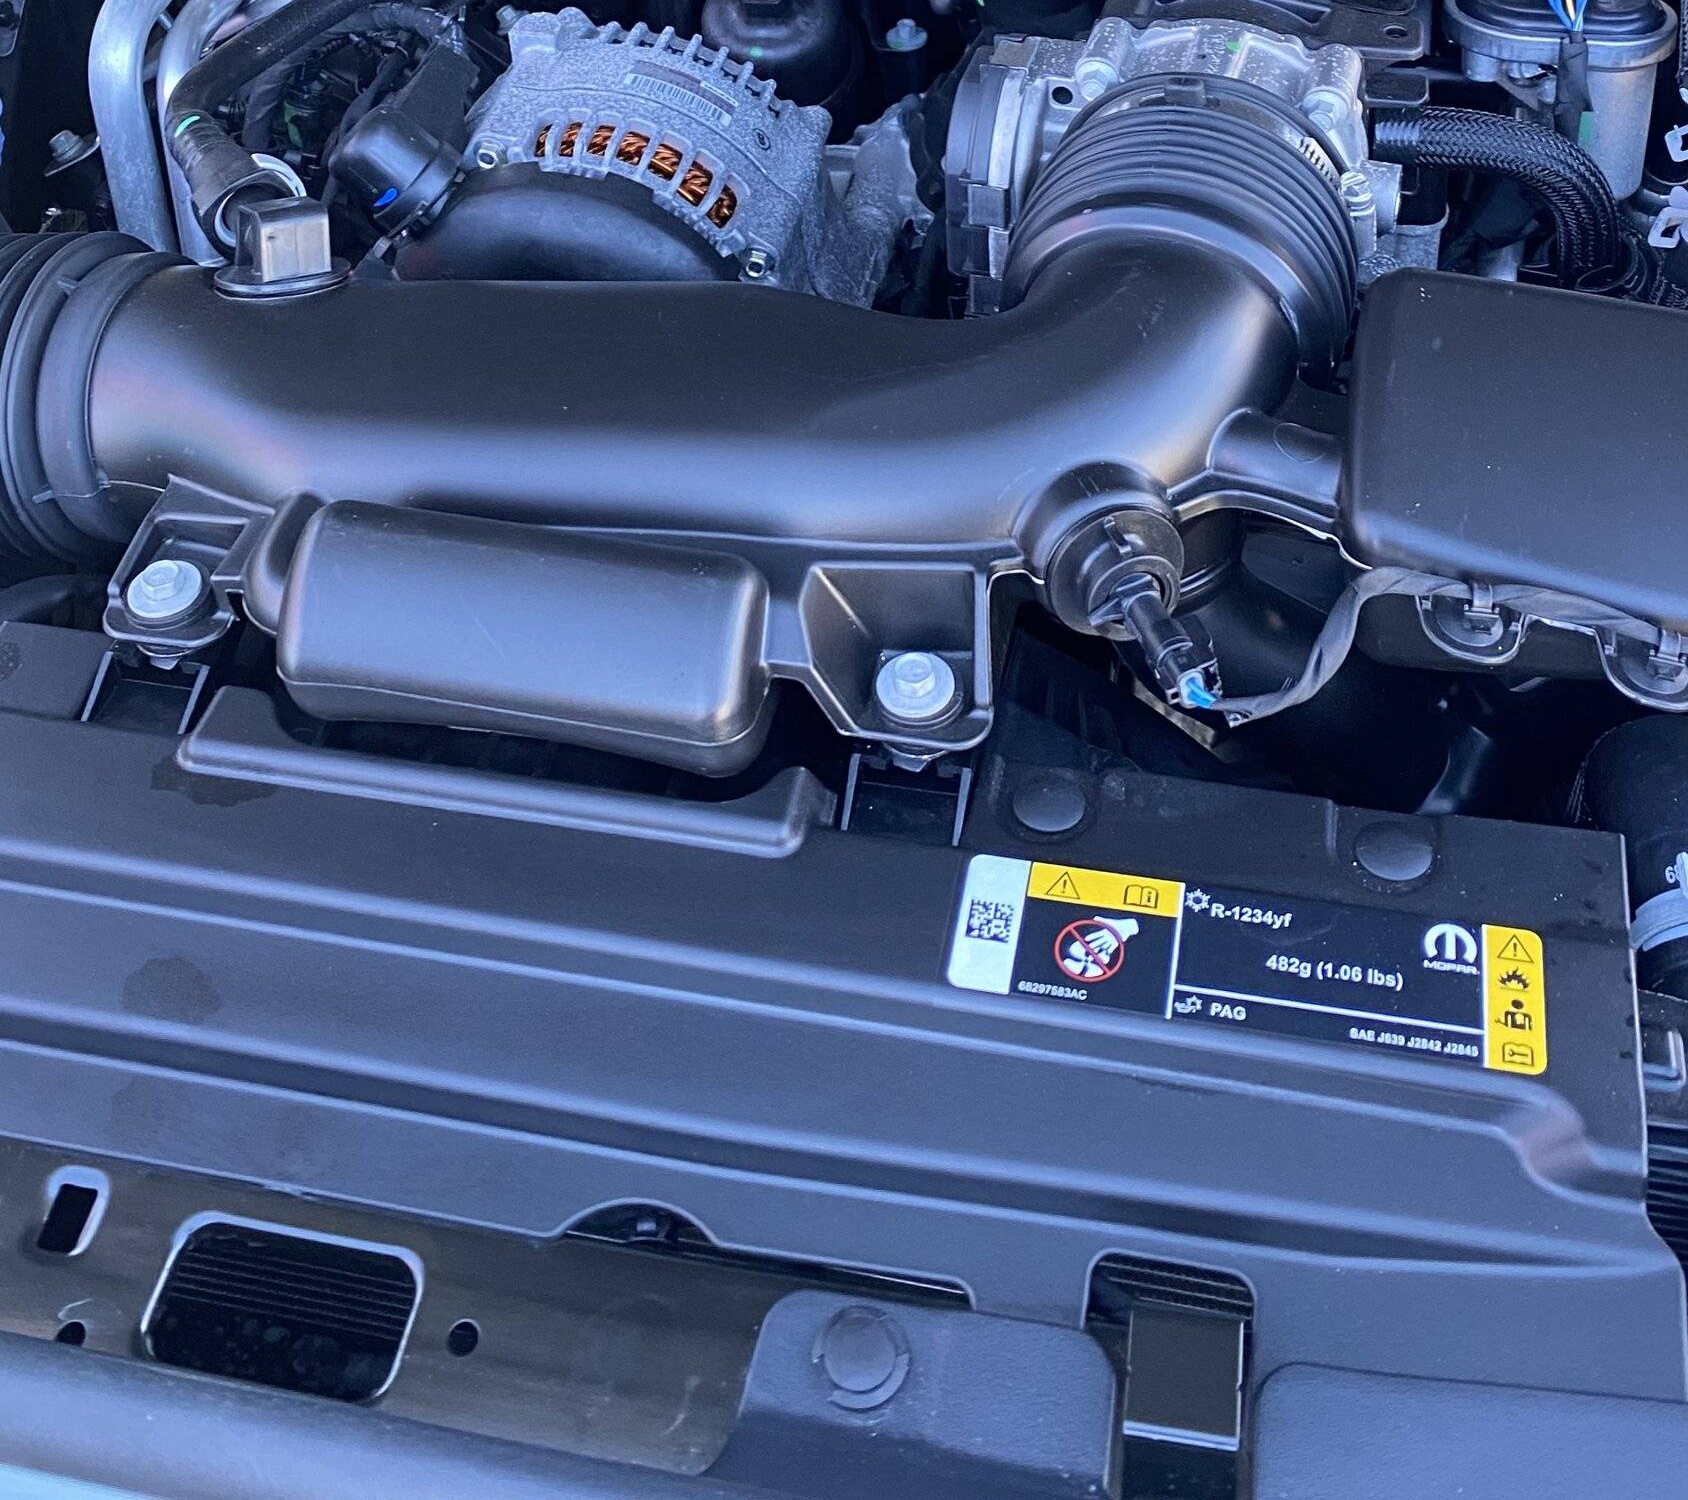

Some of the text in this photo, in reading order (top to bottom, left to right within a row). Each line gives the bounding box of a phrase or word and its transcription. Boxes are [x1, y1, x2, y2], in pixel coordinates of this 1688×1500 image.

[1211, 903, 1293, 929] R-1234yf
[1265, 955, 1404, 991] 482g (1.06 lbs)
[1423, 959, 1479, 975] MOPAR
[1210, 1002, 1247, 1021] PAG
[1349, 1027, 1376, 1042] SAE
